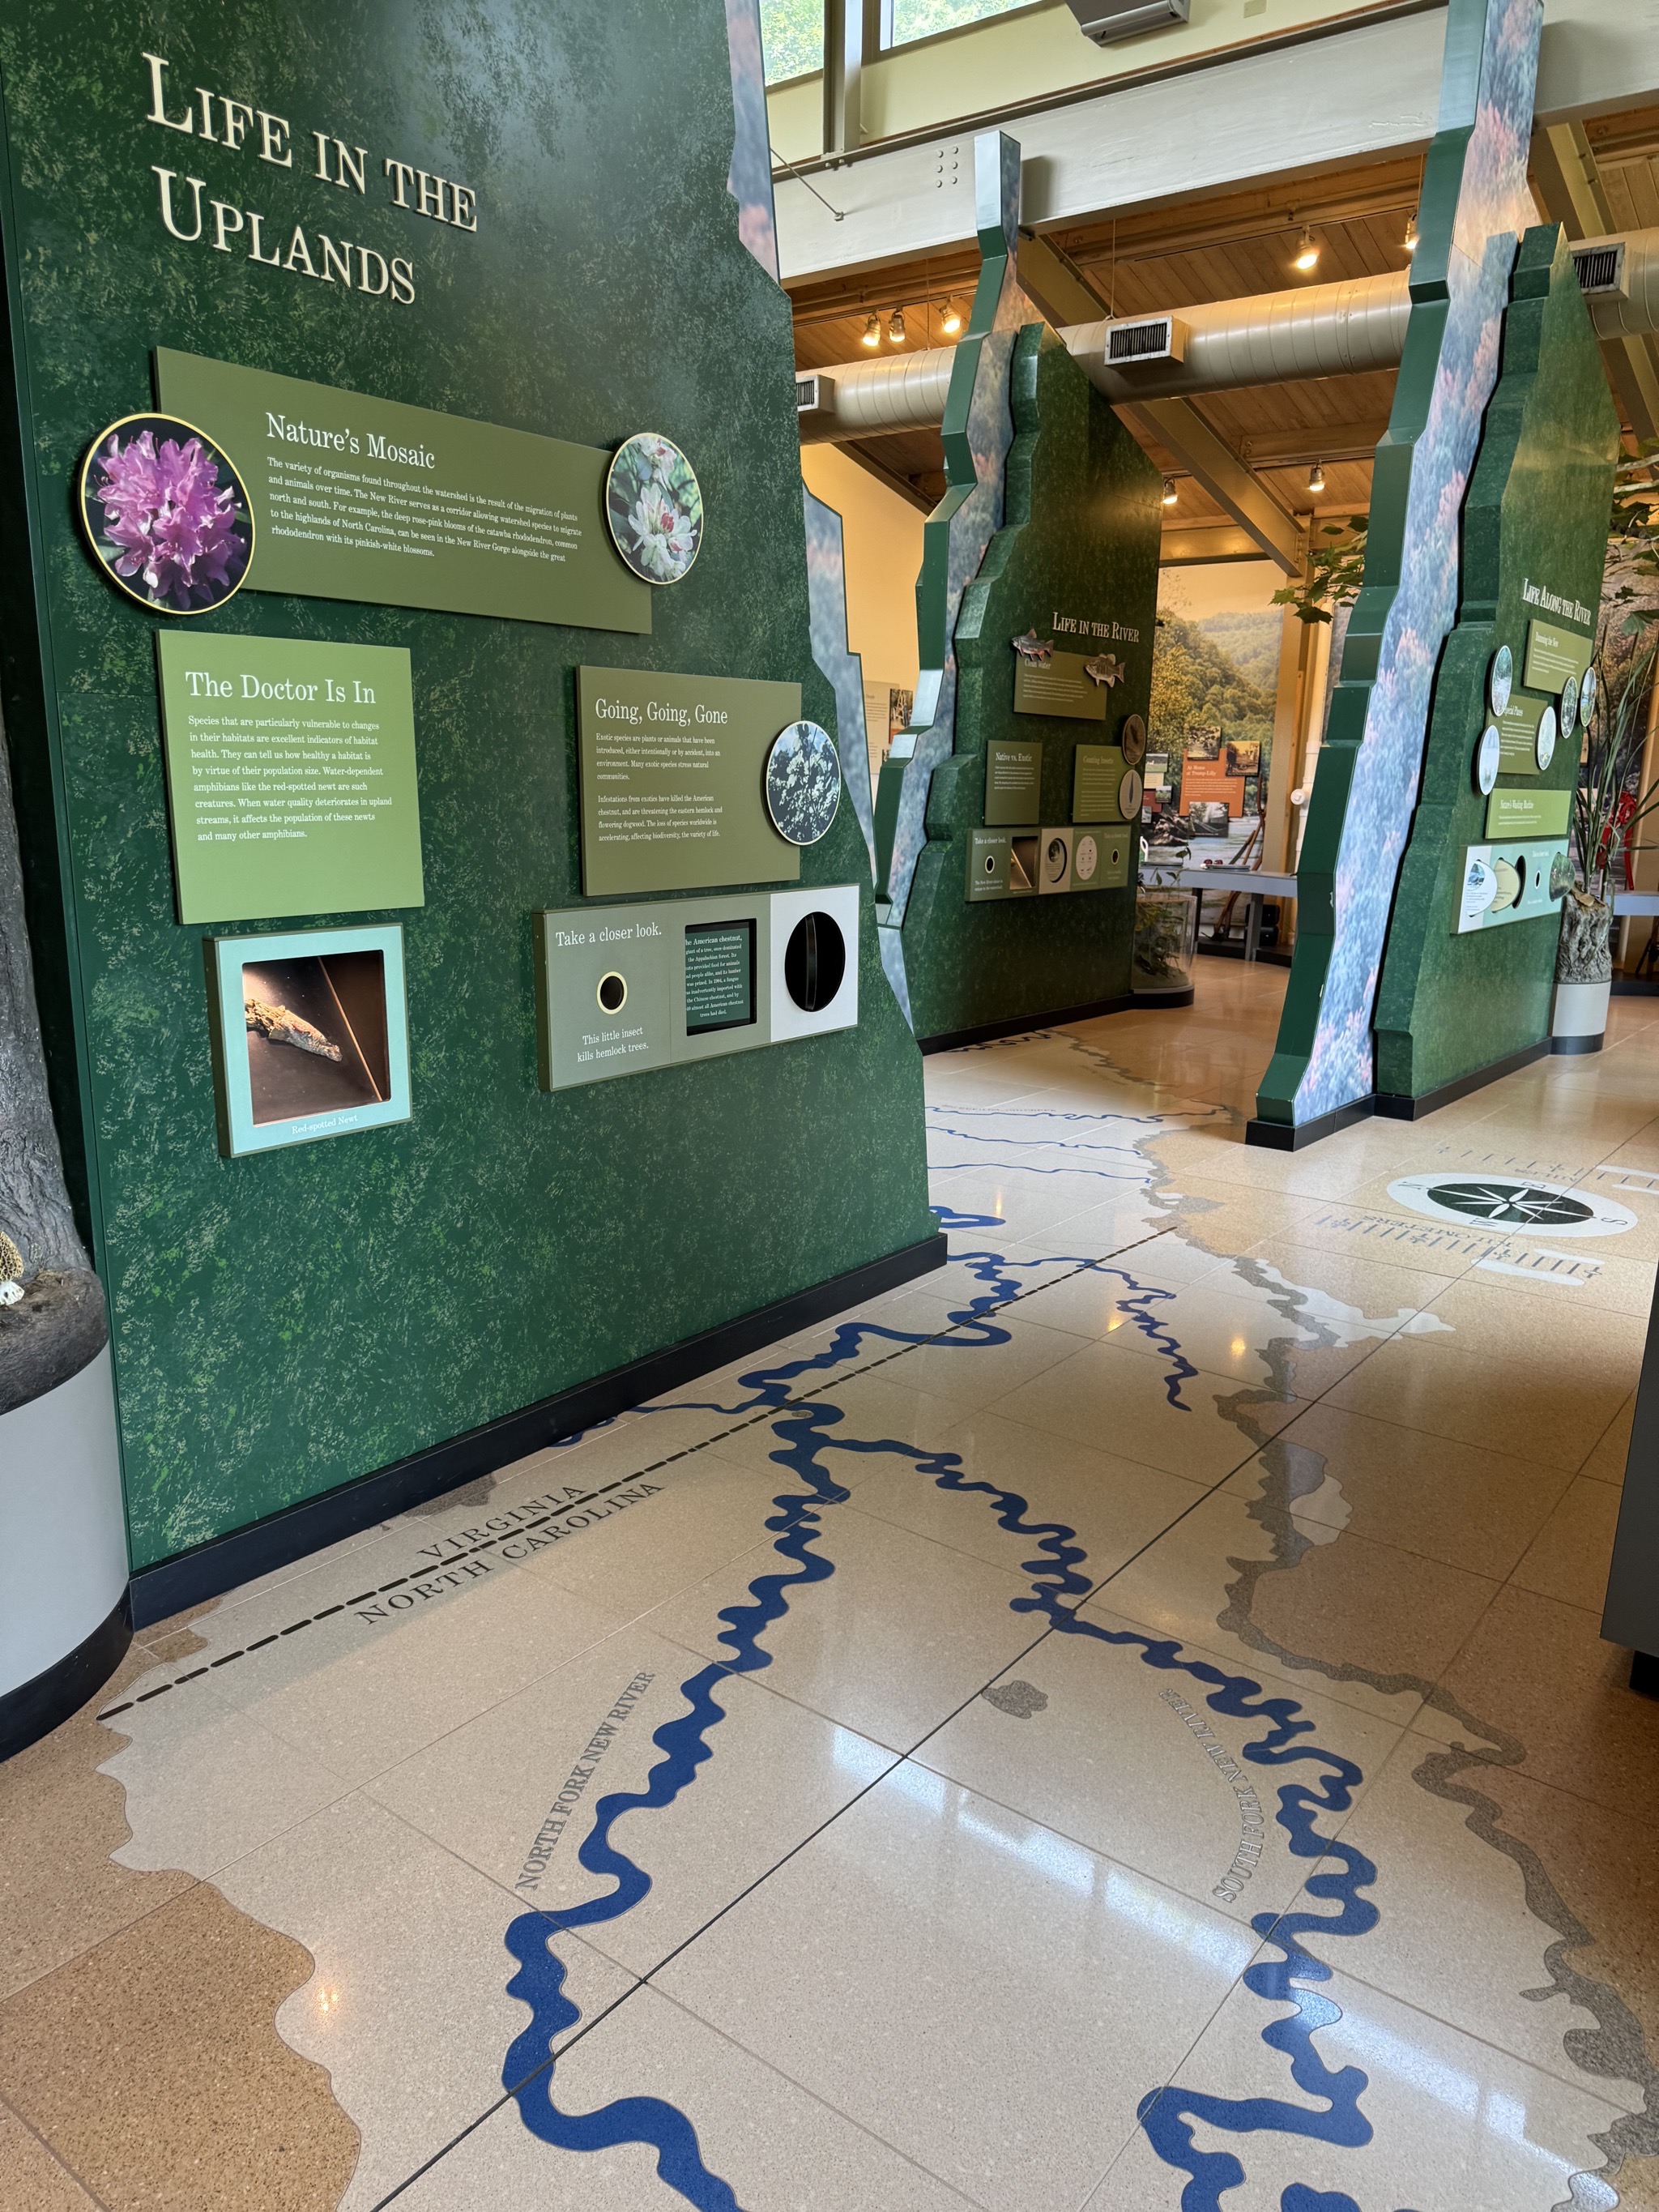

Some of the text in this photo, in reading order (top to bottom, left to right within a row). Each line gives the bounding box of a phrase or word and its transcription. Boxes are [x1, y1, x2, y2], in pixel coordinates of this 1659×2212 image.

[141, 51, 478, 233] LIFE IN THE
[151, 164, 416, 306] UPLANDS
[266, 412, 435, 468] Nature's Mosaic
[267, 456, 578, 520] The variety of organisms found throughout the watershed is the result of the migration of plants
[271, 525, 434, 557] rhododendron with its pinkish-white blossoms.
[1053, 612, 1140, 643] LIFE IN THE RIVER
[186, 671, 376, 703] The Doctor Is In
[188, 715, 220, 727] Species
[221, 716, 238, 725] that
[255, 718, 300, 730] particularly
[301, 719, 340, 728] vulnerable
[342, 720, 350, 728] to
[351, 720, 379, 732] changes
[595, 698, 727, 727] Going, Going, Gone
[190, 732, 198, 741] in
[200, 732, 220, 742] their
[222, 732, 254, 742] habitats
[271, 734, 305, 743] excellent
[307, 735, 343, 744] indicators
[344, 736, 352, 744] of
[353, 736, 377, 745] habitat
[596, 732, 612, 741] Exotic
[613, 734, 631, 743] species
[642, 734, 656, 744] plants
[663, 735, 681, 743] animals
[693, 736, 703, 744] have
[192, 765, 383, 777] by virtue of their population size. Water-dependent
[596, 759, 629, 767] environment.
[630, 759, 644, 769] Many
[660, 760, 676, 770] species
[692, 760, 708, 768] natural
[193, 782, 239, 793] amphibians
[241, 782, 256, 791] like
[258, 782, 271, 791] the
[272, 782, 316, 793] red-spotted
[318, 783, 336, 791] newt
[351, 782, 367, 791] such
[194, 796, 391, 809] creatures. When water quality deteriorates in upland
[197, 829, 307, 842] and many other amphibians.
[555, 922, 661, 946] Take a closer look.
[582, 1027, 643, 1046] This little insect
[578, 1042, 648, 1062] kills hemlock trees.
[292, 1115, 357, 1134] Red-spotted Newt
[417, 1484, 587, 1561] VIRGINIA
[353, 1481, 665, 1625] NORTH CAROLINA
[514, 1672, 655, 1891] NORTH FORK NEW RIVER
[1158, 1689, 1265, 1903] SOUTH FORK NEW RIVER
